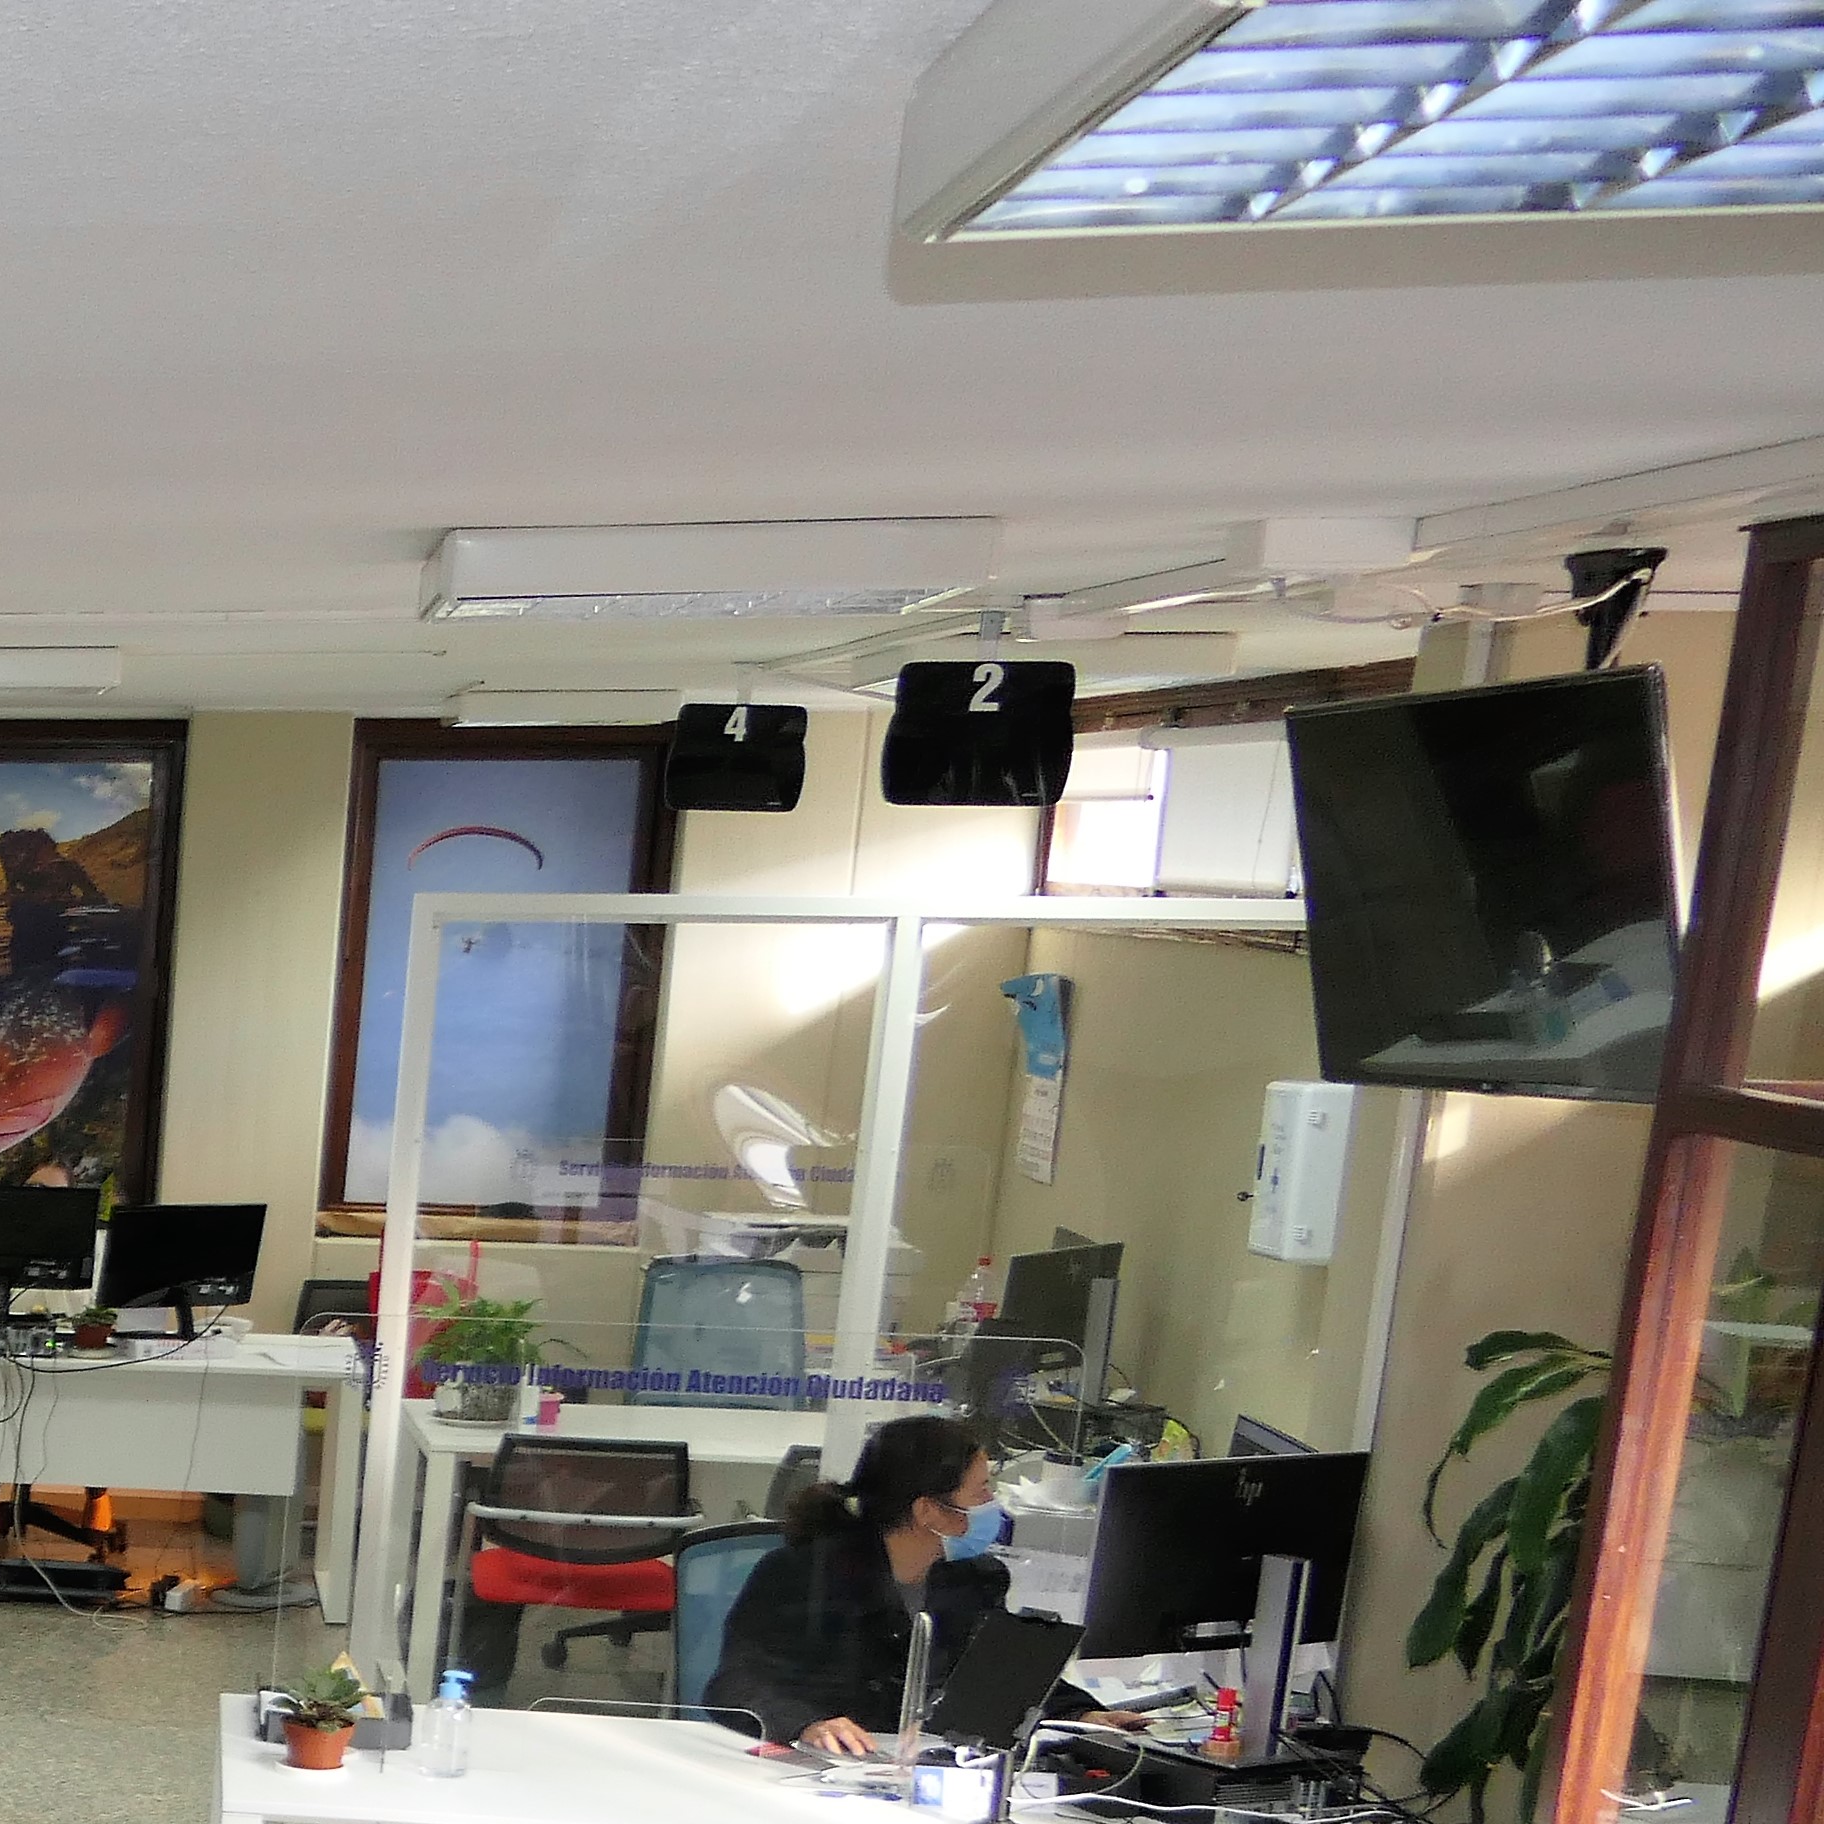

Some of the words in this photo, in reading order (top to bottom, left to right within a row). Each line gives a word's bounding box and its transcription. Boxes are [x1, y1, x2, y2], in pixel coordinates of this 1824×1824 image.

[971, 662, 1006, 712] 2
[723, 705, 748, 743] 4
[530, 1363, 681, 1392] Información
[686, 1368, 801, 1397] Atención
[807, 1374, 946, 1403] Ciudadana
